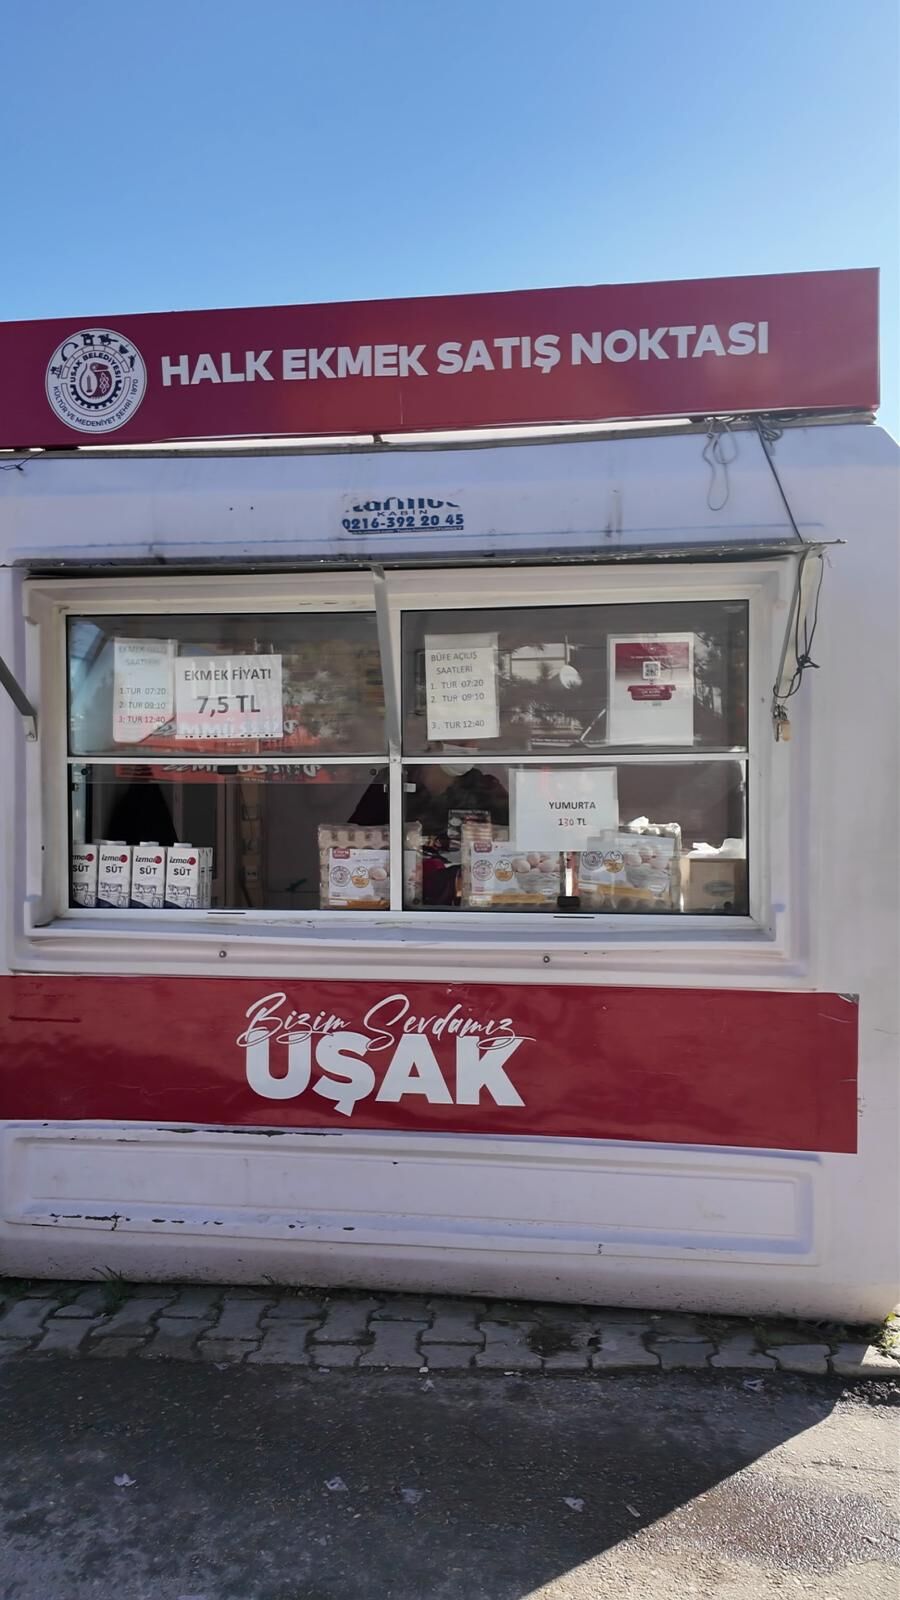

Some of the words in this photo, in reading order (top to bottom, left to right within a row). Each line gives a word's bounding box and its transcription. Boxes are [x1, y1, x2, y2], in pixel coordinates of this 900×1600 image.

[160, 349, 275, 387] HALK
[281, 343, 430, 381] EKMEK
[436, 335, 561, 374] SATIŞ
[570, 321, 769, 365] NOKTASI
[53, 386, 68, 413] KÜLTÜR
[67, 410, 76, 420] VE
[342, 516, 415, 530] 0216-392
[420, 515, 440, 526] 20
[445, 514, 464, 525] 45
[431, 653, 453, 662] BÜFE
[184, 670, 229, 681] EKMEK
[232, 666, 272, 680] FİYATI
[441, 681, 457, 689] TUR
[461, 679, 484, 688] 07:20
[442, 695, 458, 703] TUR
[196, 695, 230, 717] 7,5
[235, 694, 261, 713] TL
[127, 715, 143, 723] TUR
[444, 721, 461, 729] TUR
[463, 719, 485, 728] 12:40
[548, 801, 597, 810] YUMURTA
[576, 818, 586, 826] TL
[105, 864, 123, 873] SÜT
[139, 866, 157, 875] SÜT
[173, 866, 192, 876] SÜT
[236, 991, 352, 1048] Bizim
[363, 993, 537, 1052] Sevdamız
[245, 1029, 526, 1117] UŞAK
